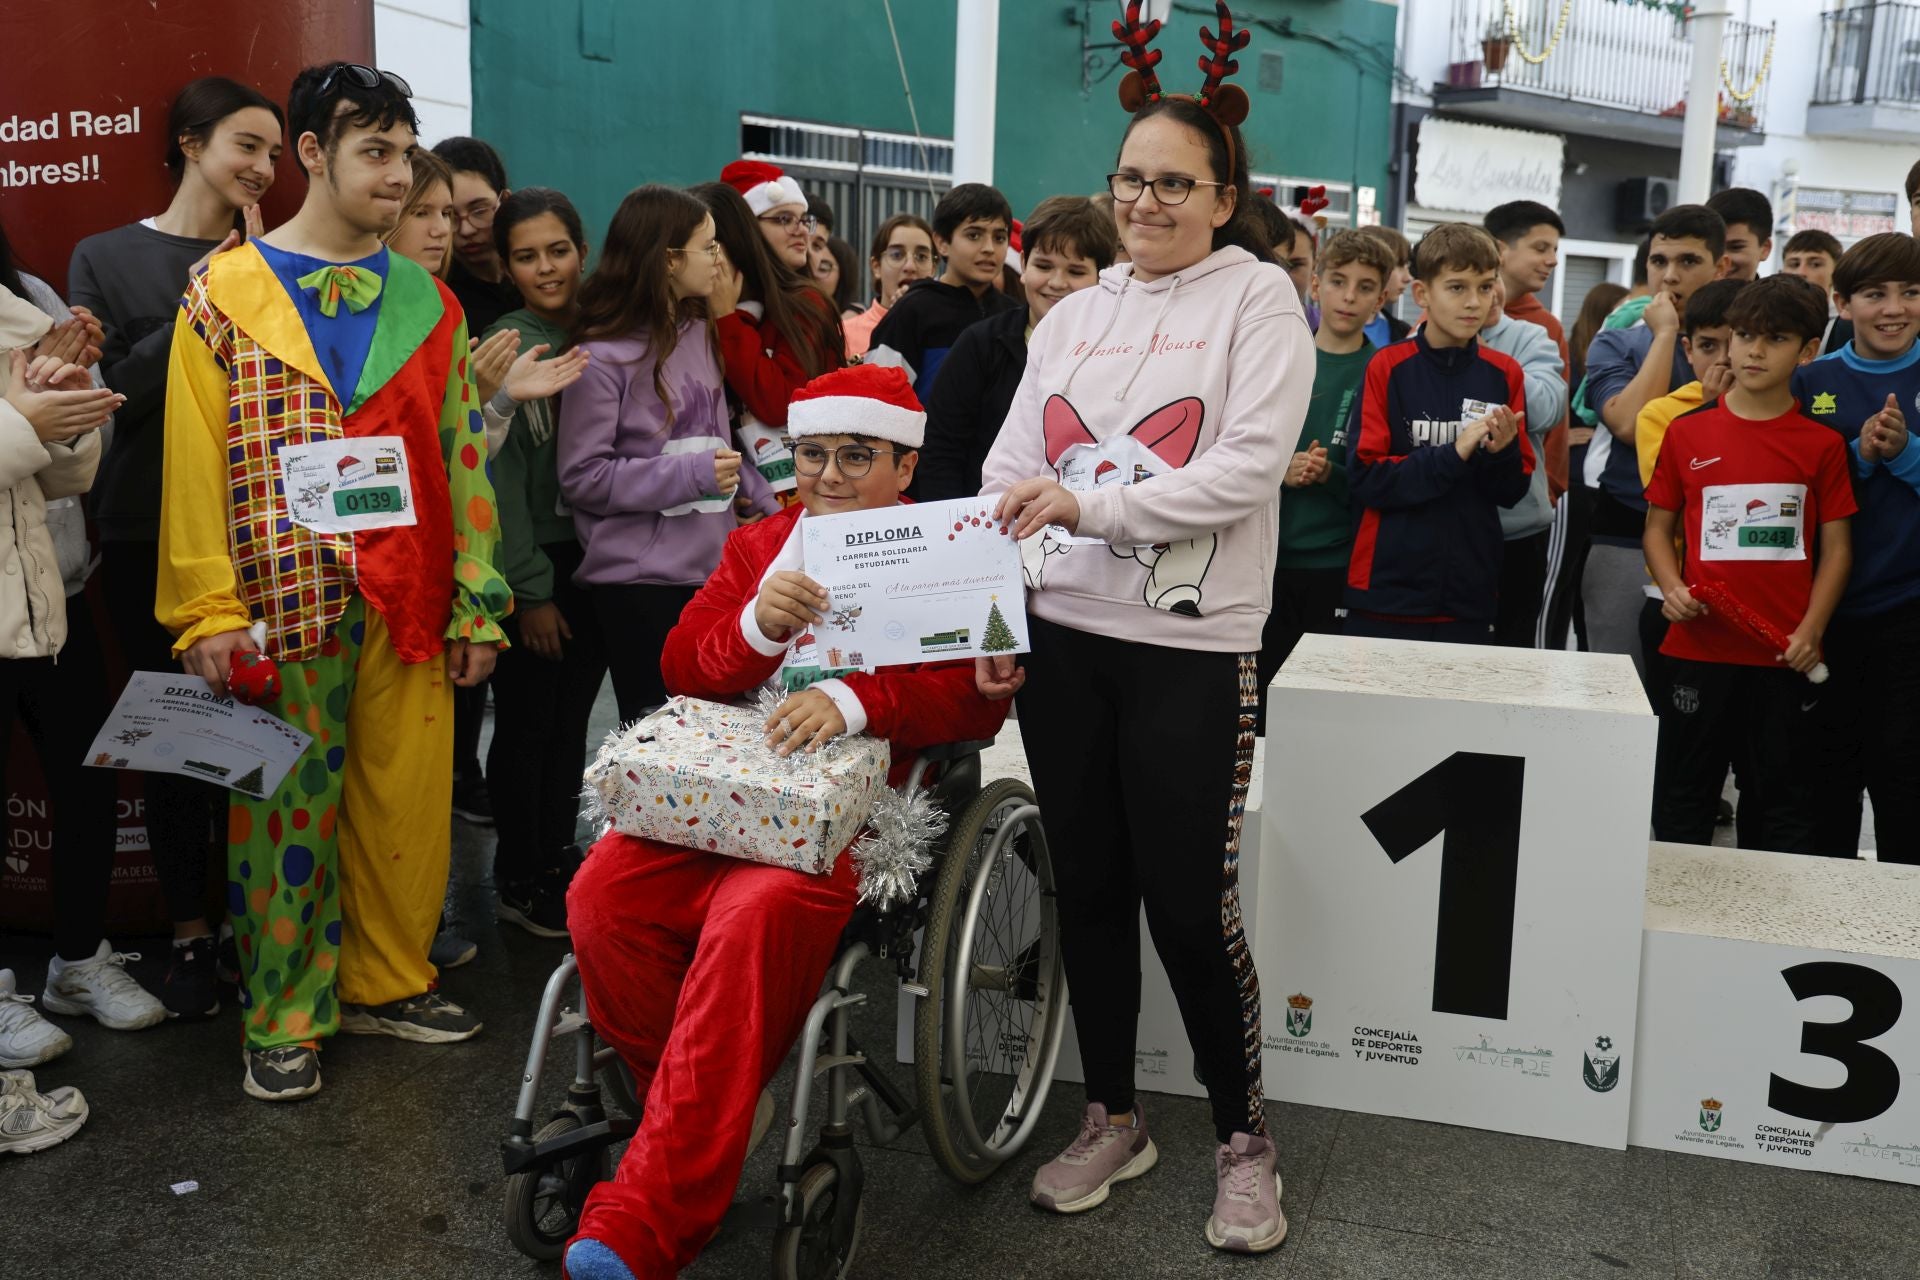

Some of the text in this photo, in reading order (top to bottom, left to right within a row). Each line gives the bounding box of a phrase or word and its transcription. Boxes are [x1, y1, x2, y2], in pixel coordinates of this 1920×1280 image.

[0, 106, 140, 143] dad Real
[1066, 333, 1207, 361] Minnie Mouse
[765, 462, 795, 481] 013
[346, 491, 391, 511] 0139
[845, 526, 923, 547] DIPLOMA
[1748, 530, 1787, 544] 0243
[842, 550, 880, 562] CARRERA
[881, 545, 928, 557] SOLIDARIA
[854, 558, 910, 570] ESTUDIANTIL
[832, 582, 857, 592] BUSCA
[858, 581, 871, 590] DEL
[164, 686, 235, 709] DIPLOMA
[155, 698, 190, 706] CARRERA
[191, 703, 233, 718] SOLIDARIA
[162, 705, 213, 719] ESTUDIANTIL
[672, 775, 713, 789] Birthday
[777, 797, 818, 811] Birthday
[708, 804, 729, 830] Happy
[714, 811, 743, 841] Birthday
[8, 829, 52, 850] DU
[1360, 751, 1526, 1021] 1
[1266, 1035, 1331, 1049] Ayuntamiento de
[1354, 1026, 1418, 1043] CONCEJALÍA
[1767, 961, 1904, 1124] 3
[1294, 1045, 1304, 1054] de
[1306, 1048, 1340, 1059] Leganés
[1352, 1037, 1422, 1055] DE DEPORTES
[1355, 1049, 1419, 1066] Y JUVENTUD
[1456, 1051, 1551, 1073] VALVERDE
[10, 1112, 34, 1132] N
[1682, 1129, 1727, 1141] Ayuntamiento
[1757, 1124, 1811, 1138] CONCEJALÍA
[1675, 1133, 1704, 1144] Valverde
[1715, 1140, 1745, 1149] Leganés
[1755, 1133, 1815, 1148] DE DEPORTES
[1757, 1142, 1812, 1157] Y JUVENTUD
